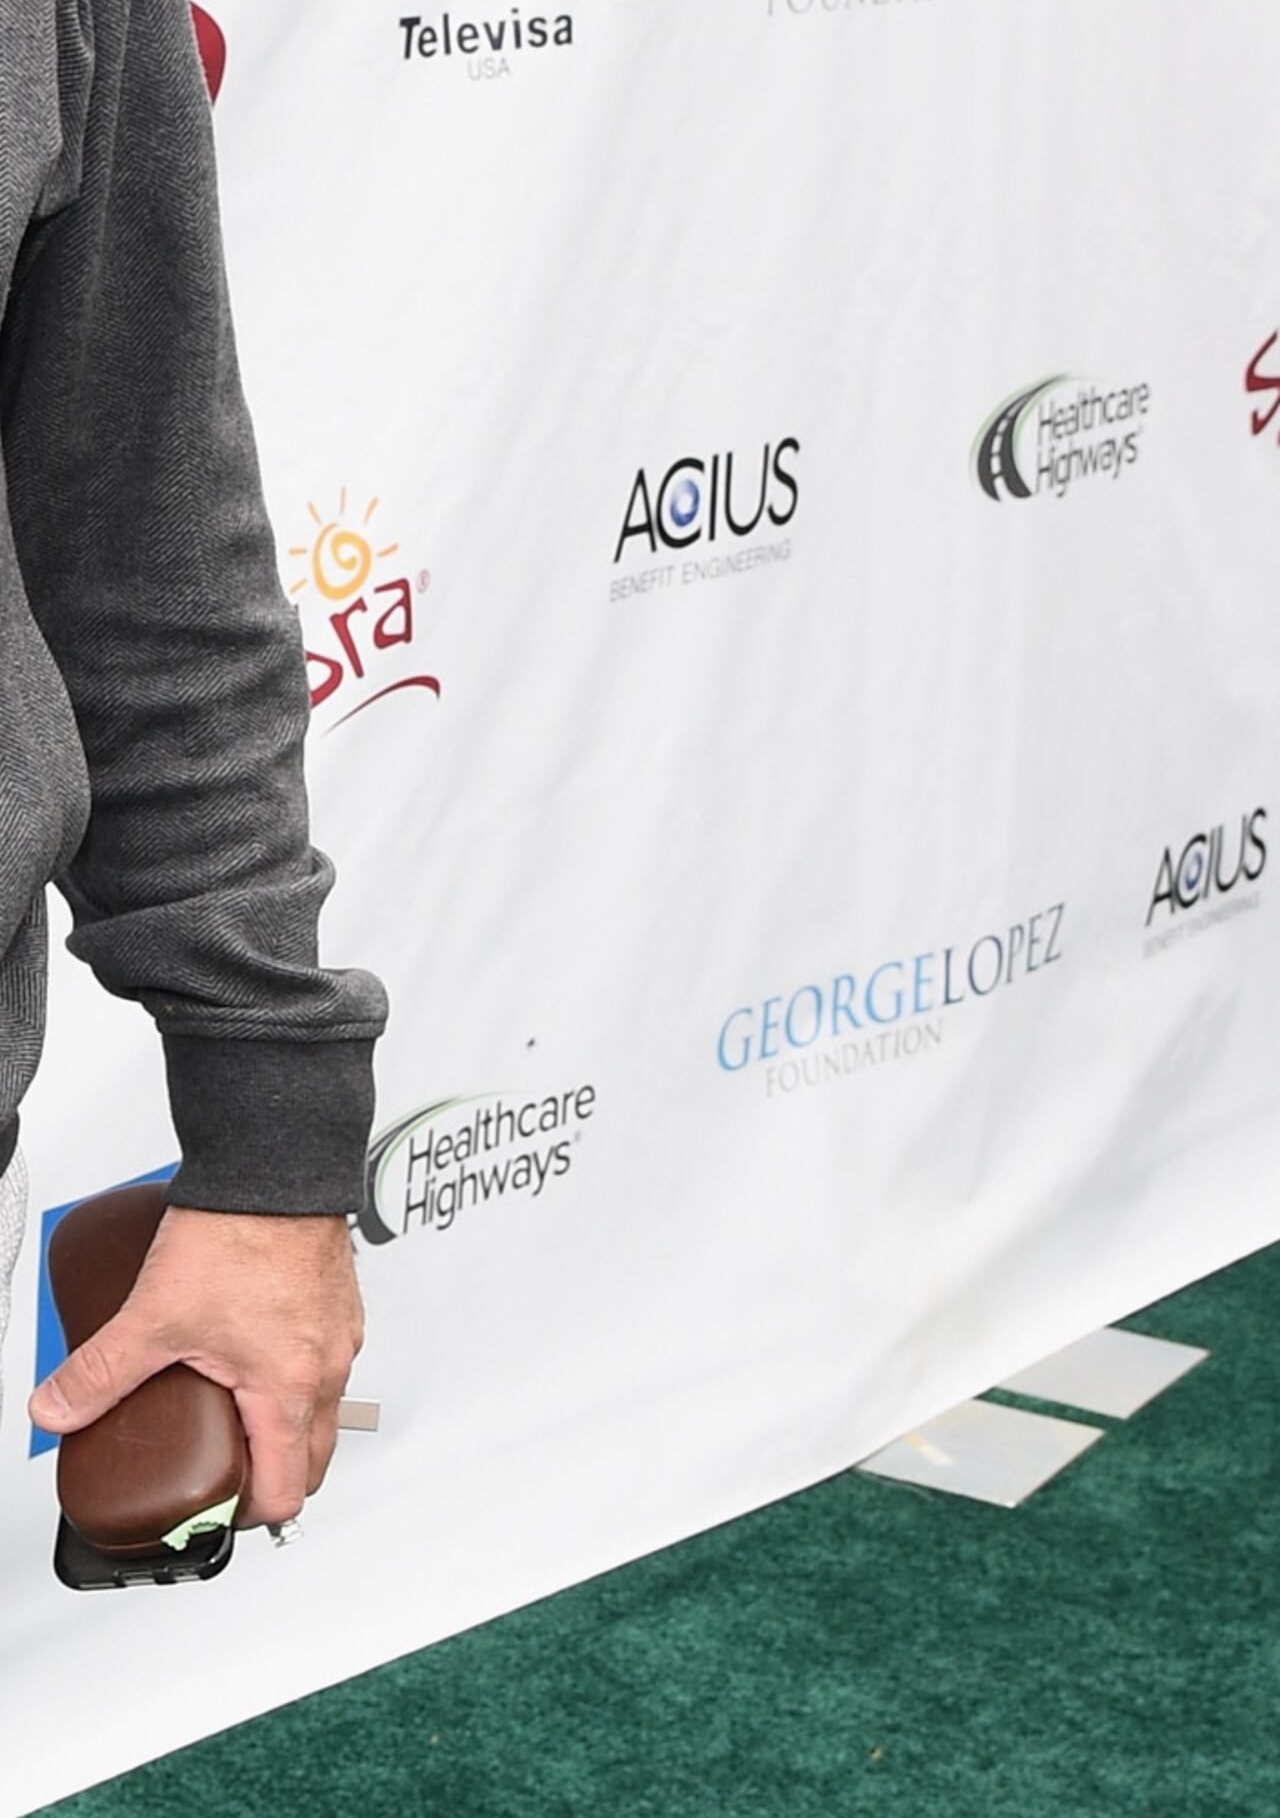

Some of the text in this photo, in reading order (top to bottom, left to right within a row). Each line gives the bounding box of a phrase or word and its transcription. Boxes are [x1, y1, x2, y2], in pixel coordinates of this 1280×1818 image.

[398, 7, 574, 60] Televisa
[467, 57, 513, 82] USA
[1037, 382, 1150, 446] Healthcare
[1035, 430, 1139, 499] Highways
[764, 1018, 944, 1098] FOUNDATION
[408, 1084, 596, 1184] Healthcare
[402, 1139, 571, 1234] Highways
